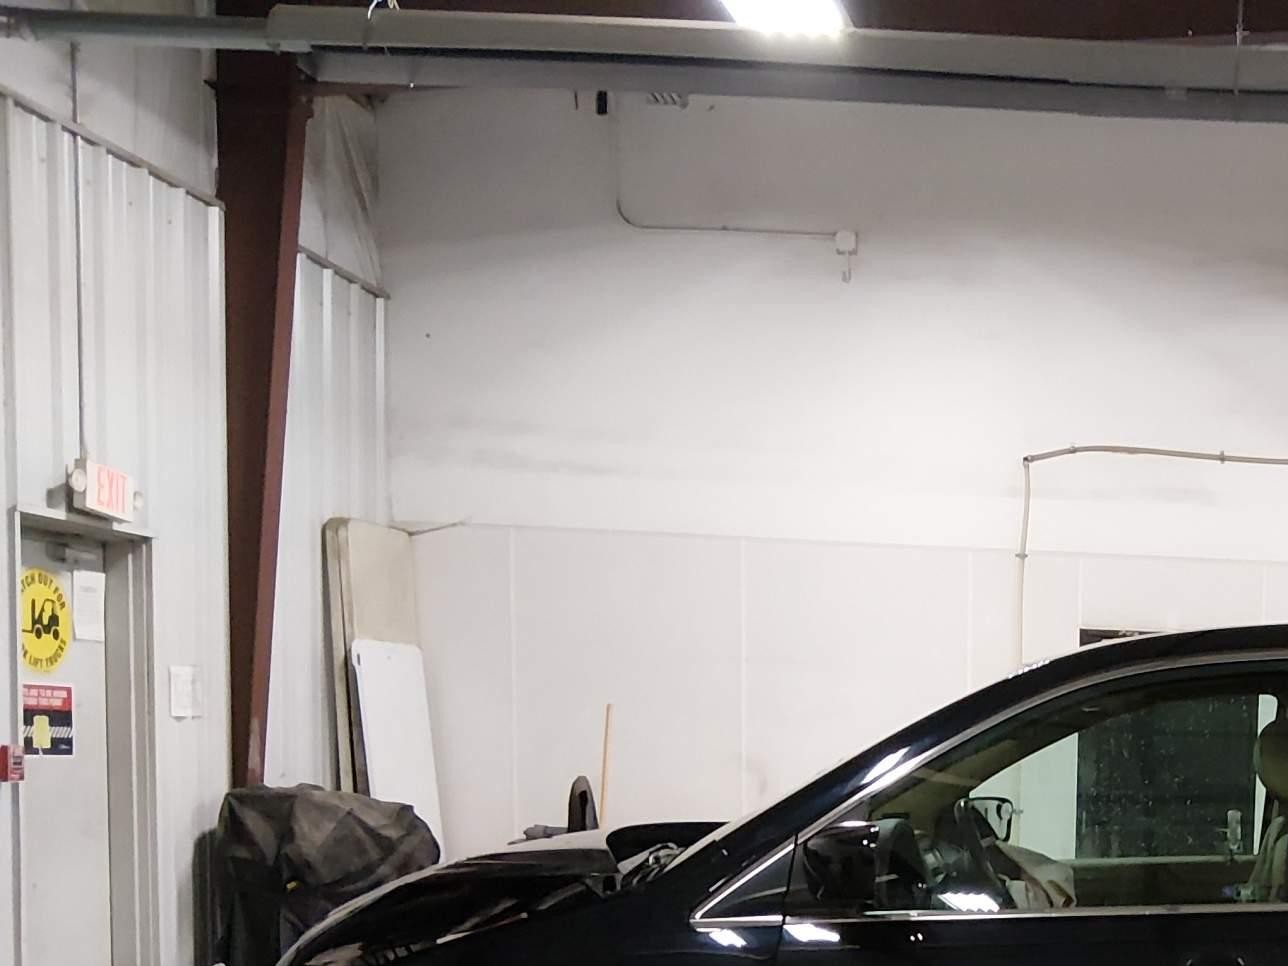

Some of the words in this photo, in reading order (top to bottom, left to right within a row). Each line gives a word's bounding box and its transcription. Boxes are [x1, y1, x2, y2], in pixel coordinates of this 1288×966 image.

[96, 465, 128, 513] EXIT
[38, 572, 53, 589] OUT
[53, 586, 66, 611] FOR
